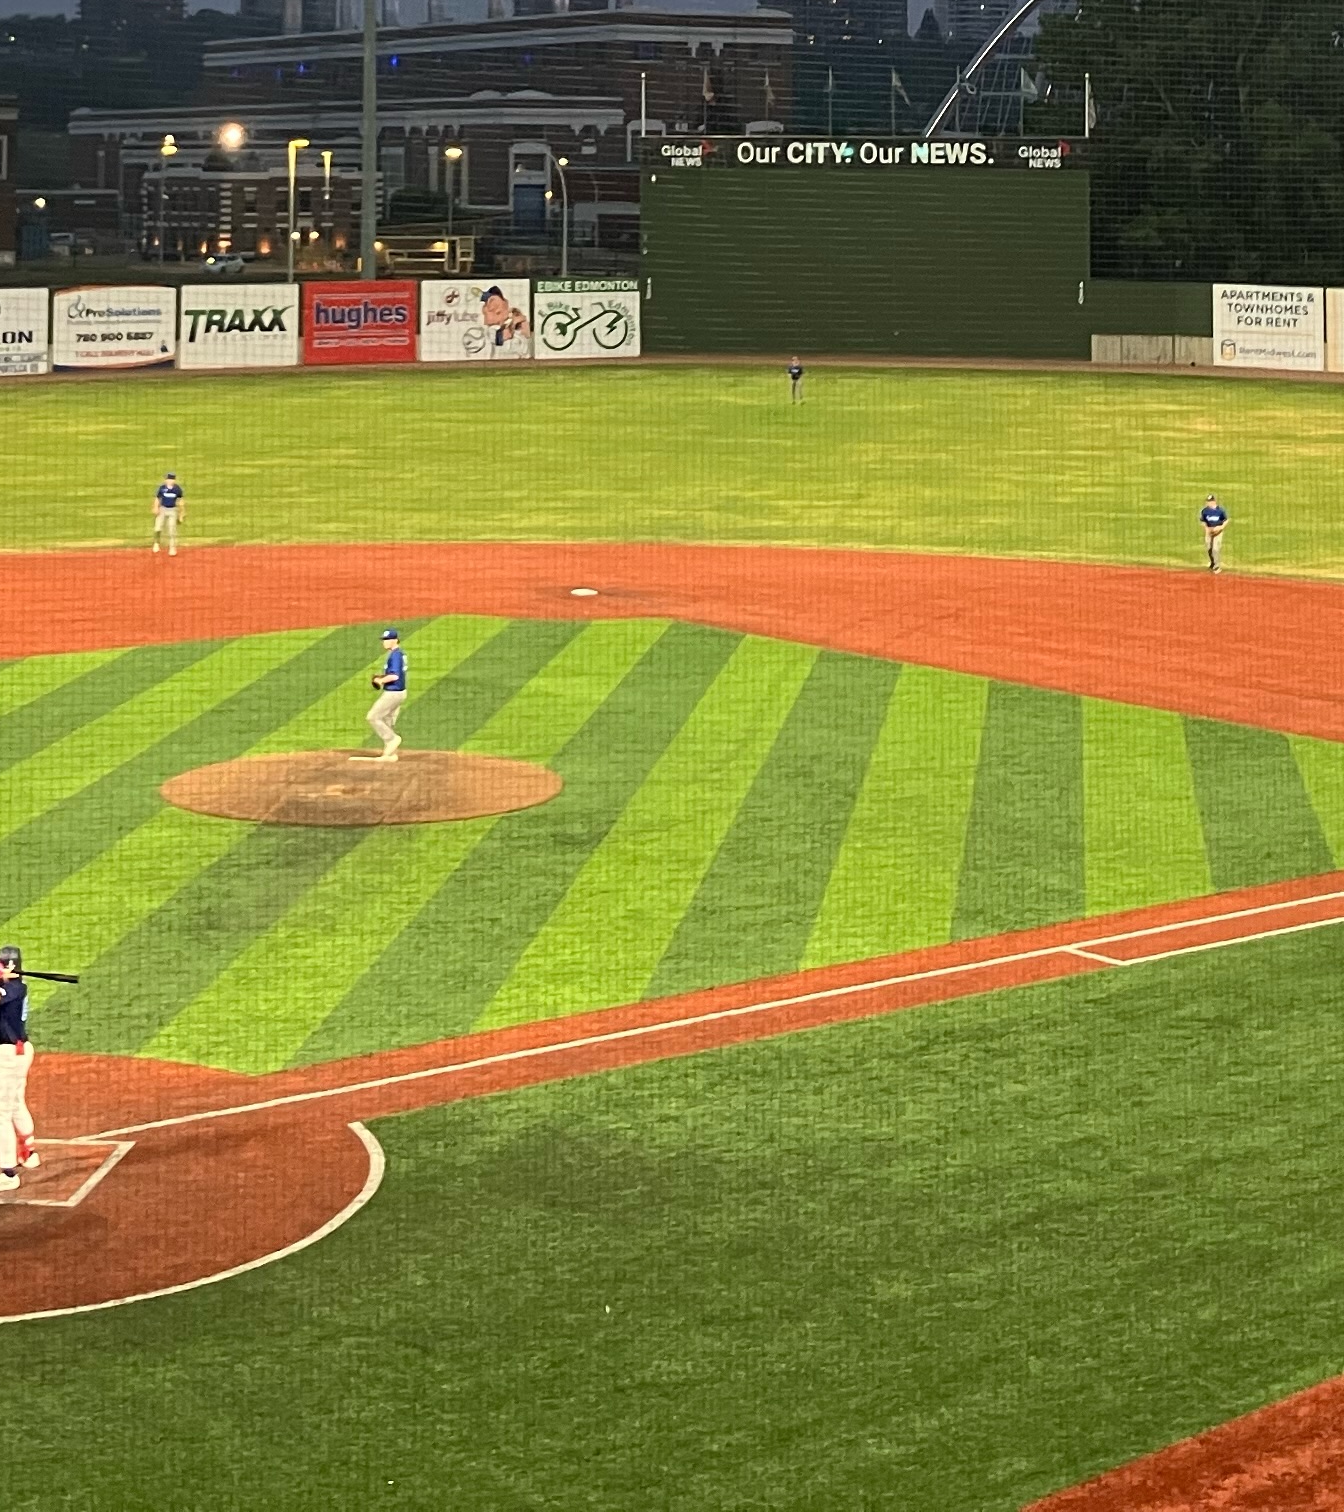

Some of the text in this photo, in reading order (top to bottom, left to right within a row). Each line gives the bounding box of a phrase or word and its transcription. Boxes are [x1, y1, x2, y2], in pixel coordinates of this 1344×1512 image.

[661, 144, 702, 157] Global
[737, 142, 780, 164] Our
[859, 142, 904, 164] Our
[910, 142, 995, 164] NEWS.
[1018, 146, 1062, 158] Global
[671, 157, 702, 167] NEWS
[1029, 158, 1061, 168] NEWS
[574, 280, 638, 291] EDMONTON
[1221, 290, 1314, 303] APARTMENTS &
[315, 301, 408, 329] hughes
[1227, 303, 1309, 316] TOWNHOMES
[184, 305, 294, 342] TRAXX
[1237, 316, 1298, 328] FOR RENT
